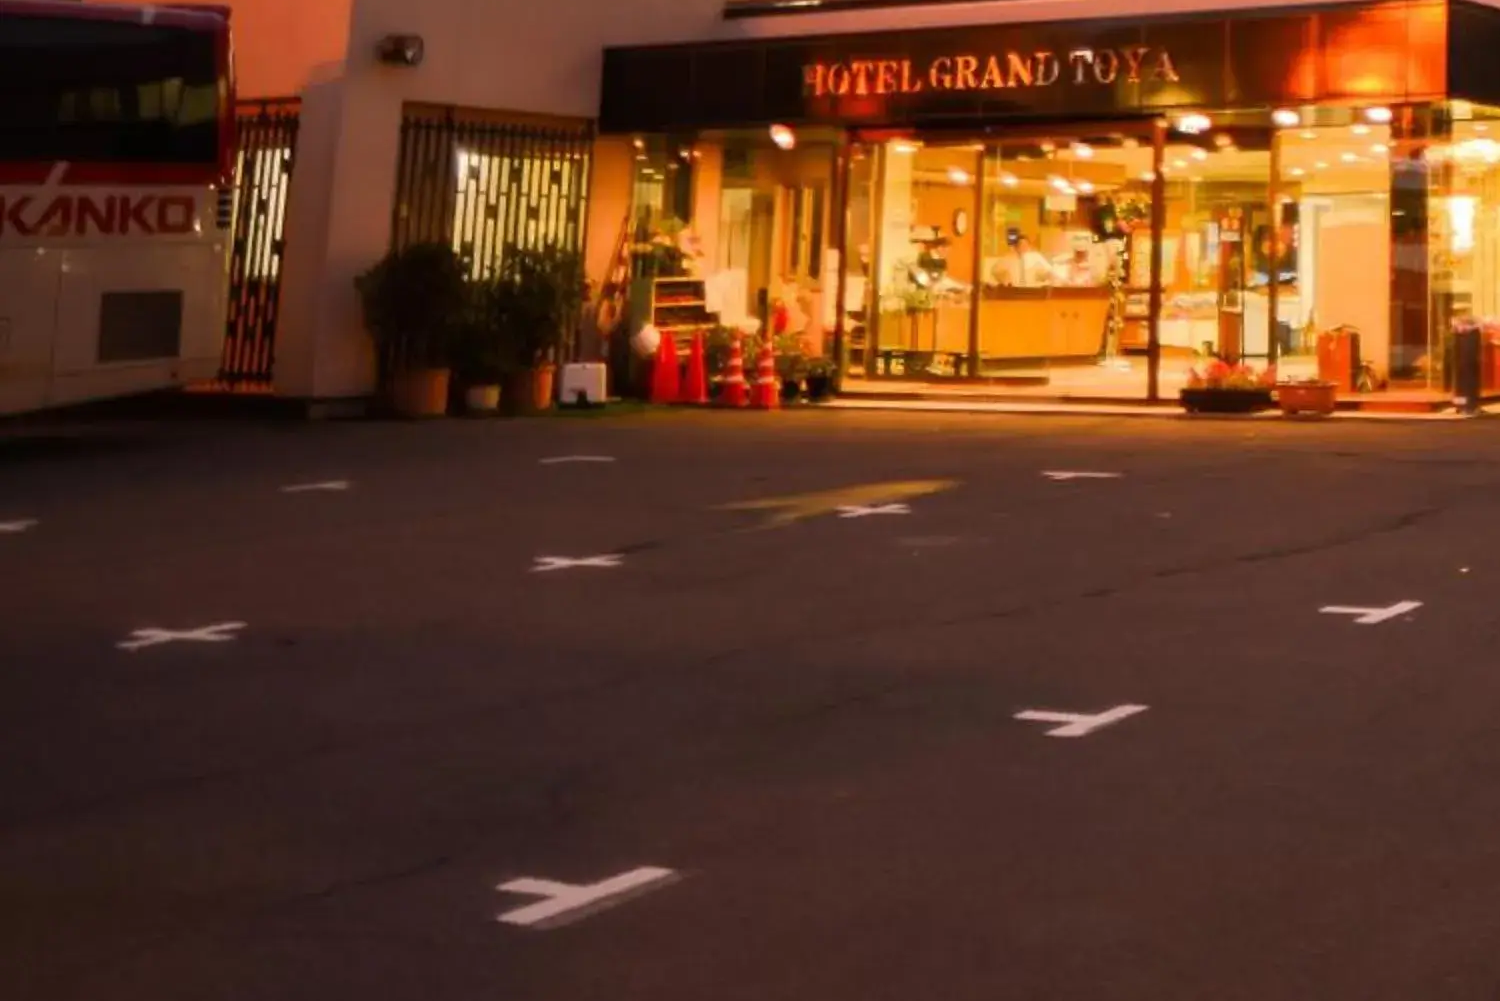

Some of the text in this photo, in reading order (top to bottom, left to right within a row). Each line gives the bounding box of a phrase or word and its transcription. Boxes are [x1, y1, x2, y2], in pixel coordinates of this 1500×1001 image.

[801, 47, 1180, 97] HOTEL GRAND TOYA
[0, 194, 196, 237] KANKO
